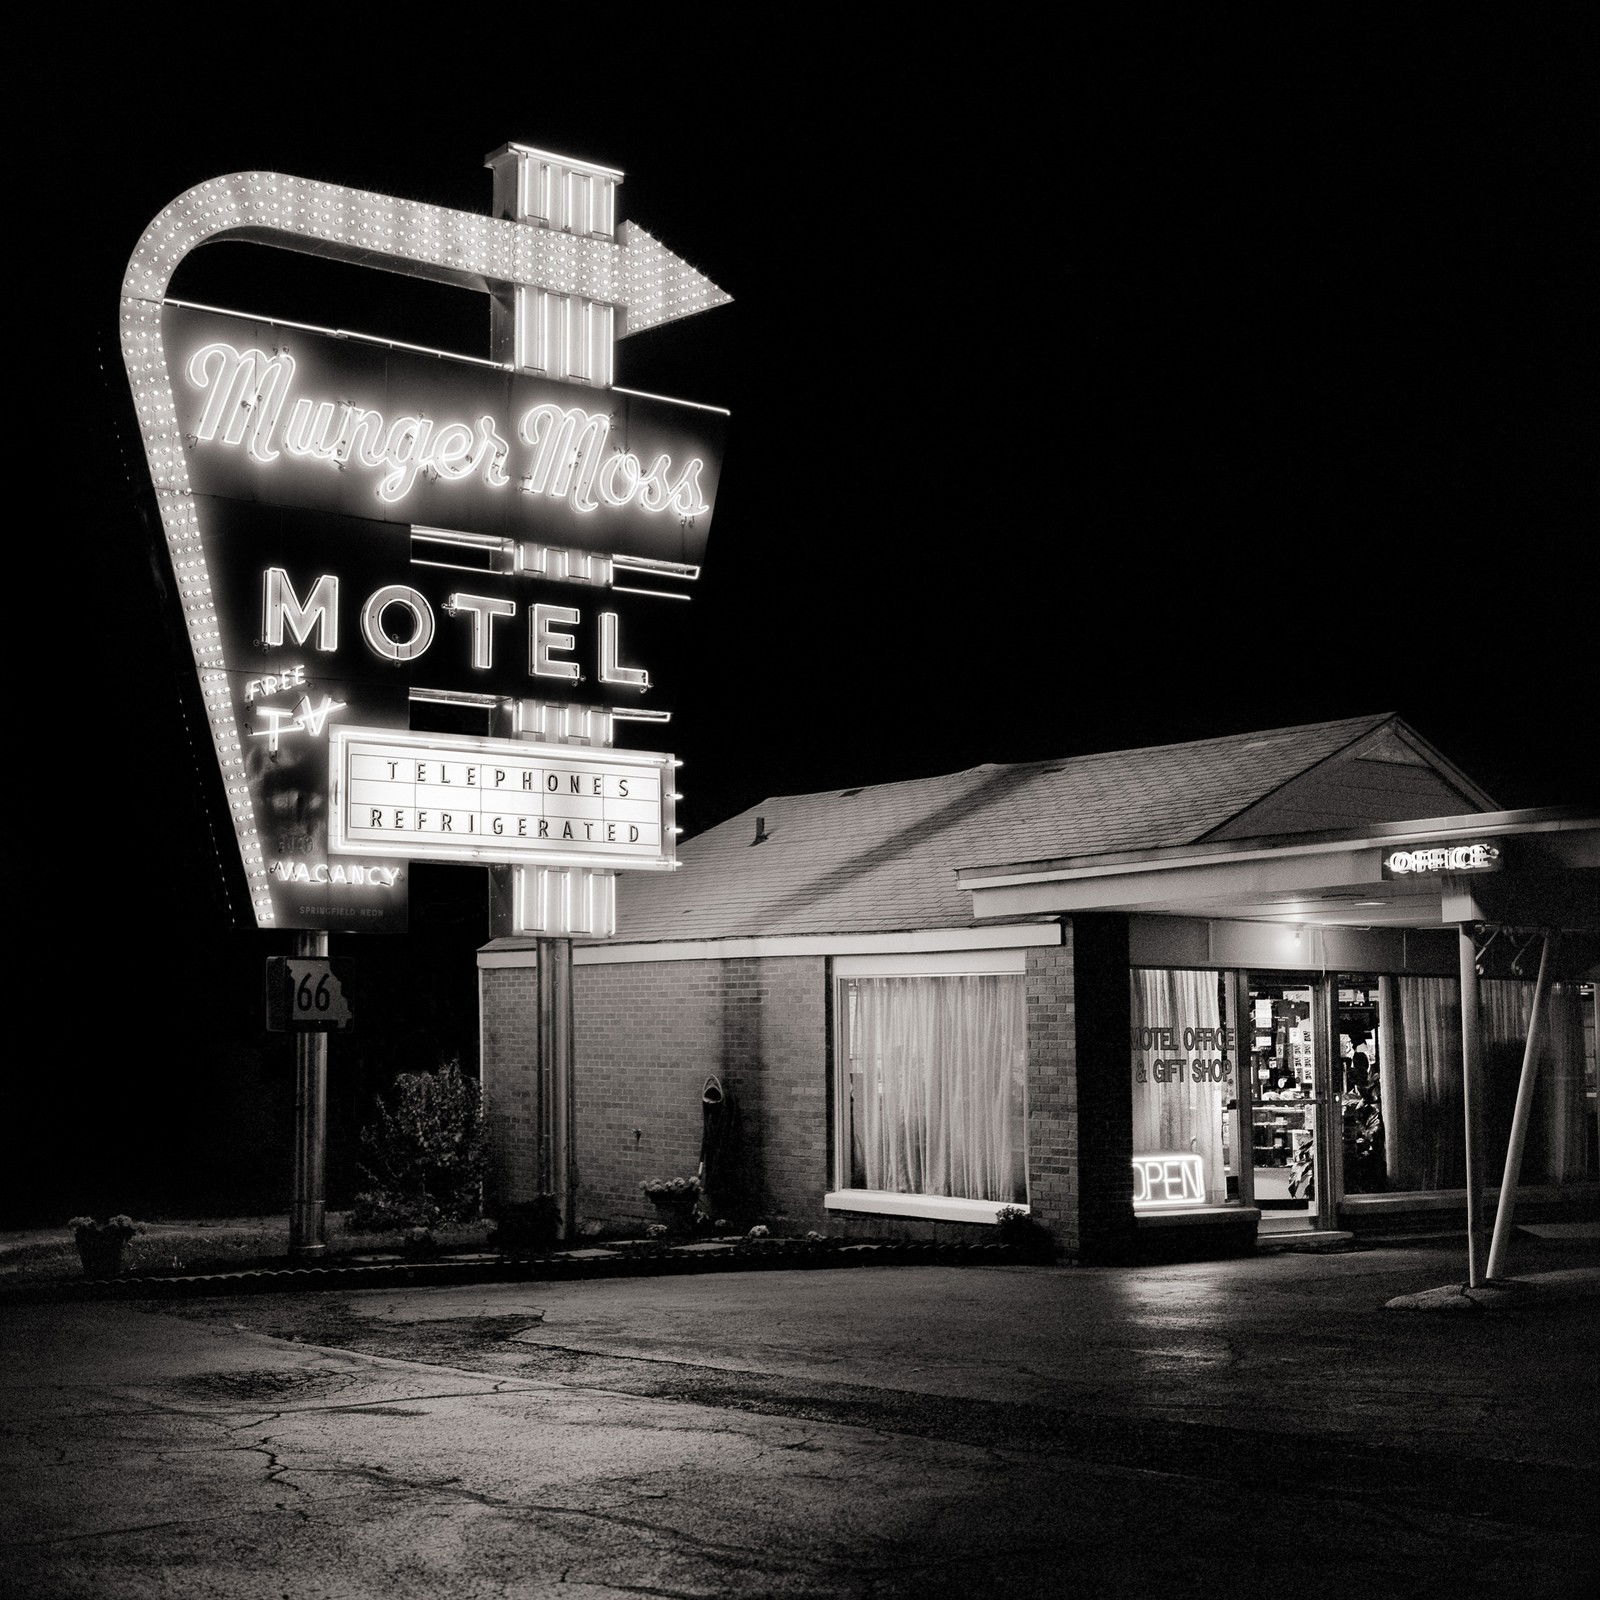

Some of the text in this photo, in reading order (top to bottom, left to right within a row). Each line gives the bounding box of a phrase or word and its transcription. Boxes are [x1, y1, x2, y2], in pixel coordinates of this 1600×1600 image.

[186, 343, 710, 516] Munger Moss
[263, 567, 649, 685] MOTEL
[246, 664, 306, 701] FREE
[256, 694, 333, 752] TV
[387, 760, 630, 798] TELEPHONES
[370, 808, 640, 843] REFRIGERATED
[274, 860, 401, 887] VACANCY
[1389, 843, 1492, 874] OFFICE
[299, 905, 384, 918] SPRINGFIELD NEON
[297, 972, 331, 1012] 66
[1183, 1026, 1235, 1051] OFFICE
[1135, 1059, 1233, 1083] & GIFT SHOP
